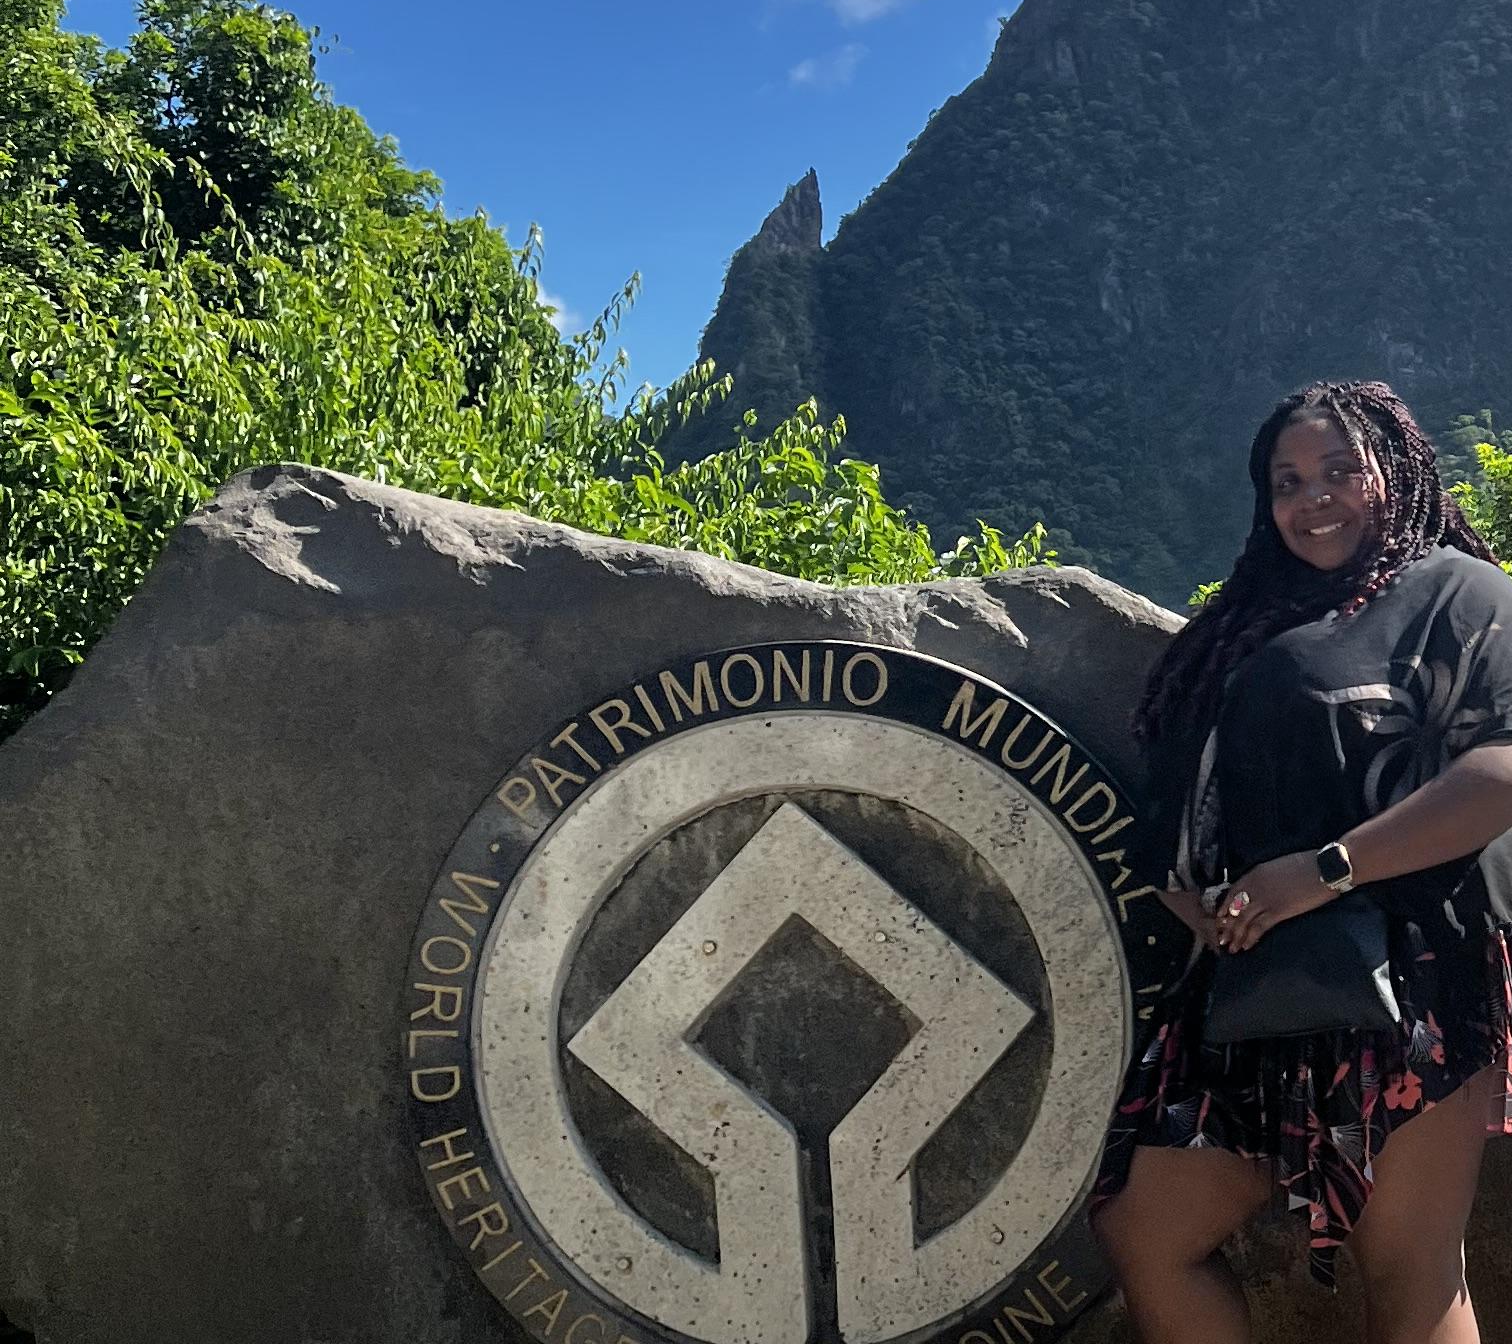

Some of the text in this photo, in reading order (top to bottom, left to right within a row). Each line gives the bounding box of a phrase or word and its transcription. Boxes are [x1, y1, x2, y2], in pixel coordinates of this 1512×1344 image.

[496, 649, 1158, 924] PATRIMONIO MUNDIAL
[410, 869, 502, 1104] WORLD
